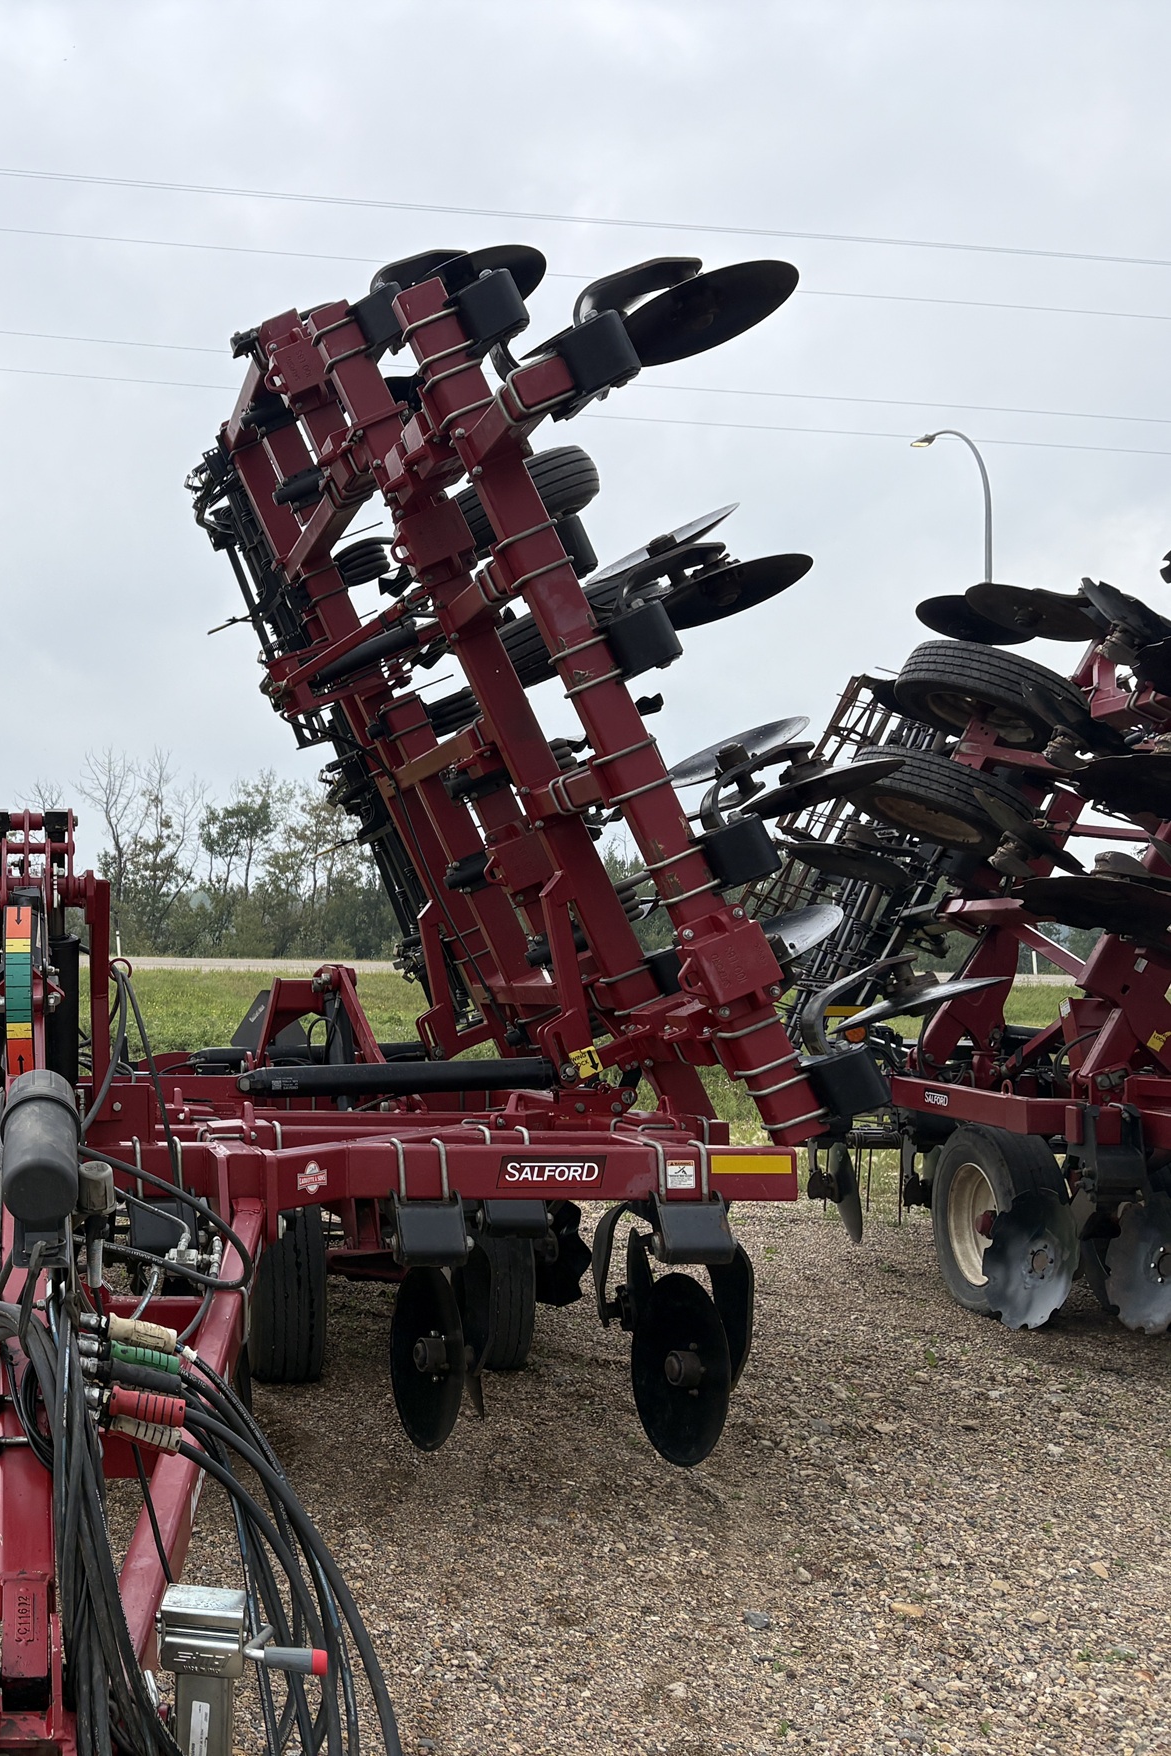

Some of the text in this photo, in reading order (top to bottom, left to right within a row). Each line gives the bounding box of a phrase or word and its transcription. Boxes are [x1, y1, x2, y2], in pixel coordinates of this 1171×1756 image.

[726, 946, 747, 983] 100 LBS
[571, 1053, 587, 1062] WING
[924, 1091, 949, 1107] SALFORD
[505, 1162, 599, 1181] SALFORD
[278, 1500, 288, 1521] ATLAS
